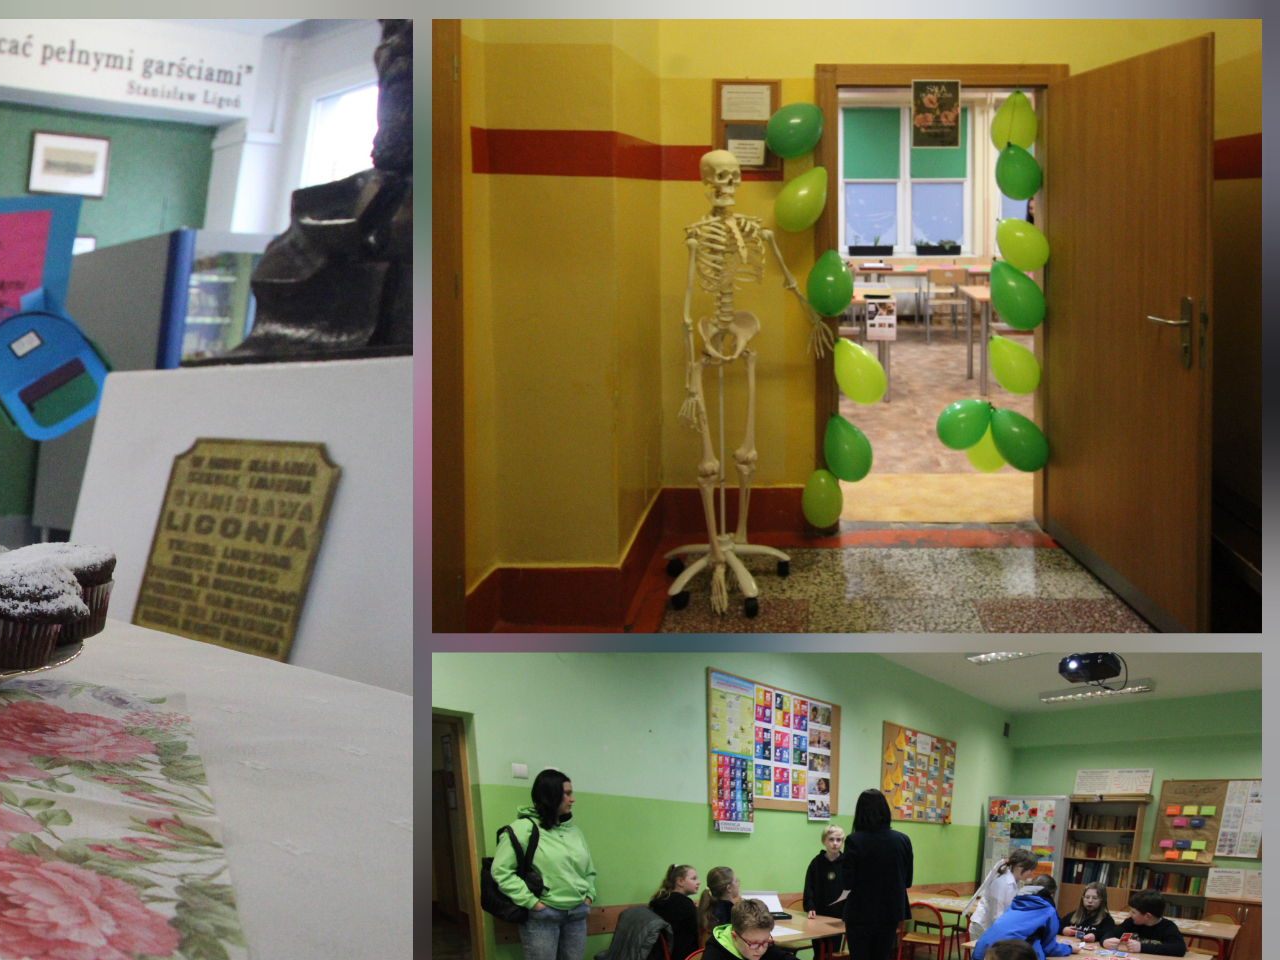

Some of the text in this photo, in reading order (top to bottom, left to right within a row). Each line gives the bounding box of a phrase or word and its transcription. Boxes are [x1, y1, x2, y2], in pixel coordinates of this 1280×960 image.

[40, 39, 134, 72] pełnymi
[127, 81, 241, 110] Stanisław Ligoń
[165, 511, 307, 550] LIGONIA
